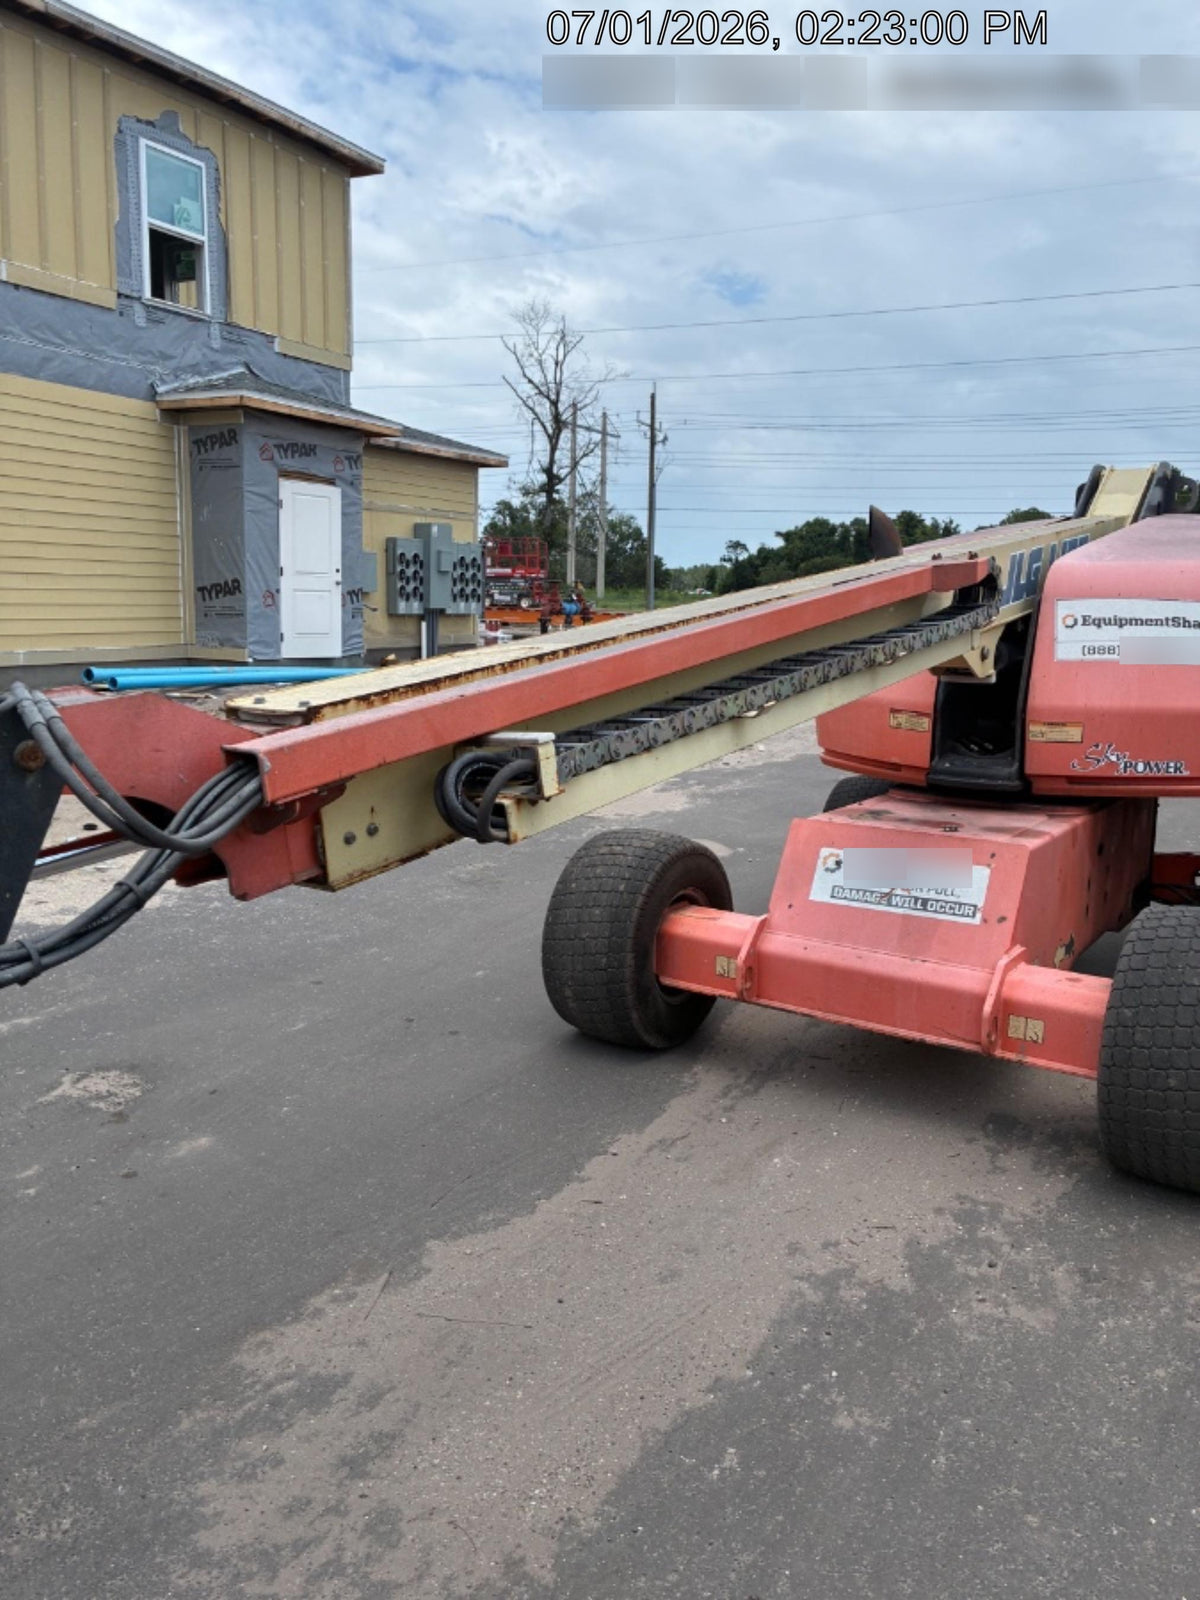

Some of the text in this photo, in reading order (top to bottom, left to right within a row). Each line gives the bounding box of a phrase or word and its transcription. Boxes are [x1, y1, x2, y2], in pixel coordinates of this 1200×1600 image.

[192, 428, 238, 455] TYPAR
[197, 577, 242, 601] TYPAR
[1120, 759, 1184, 774] POWER
[891, 895, 924, 910] WILL
[927, 900, 974, 917] OCCUR
